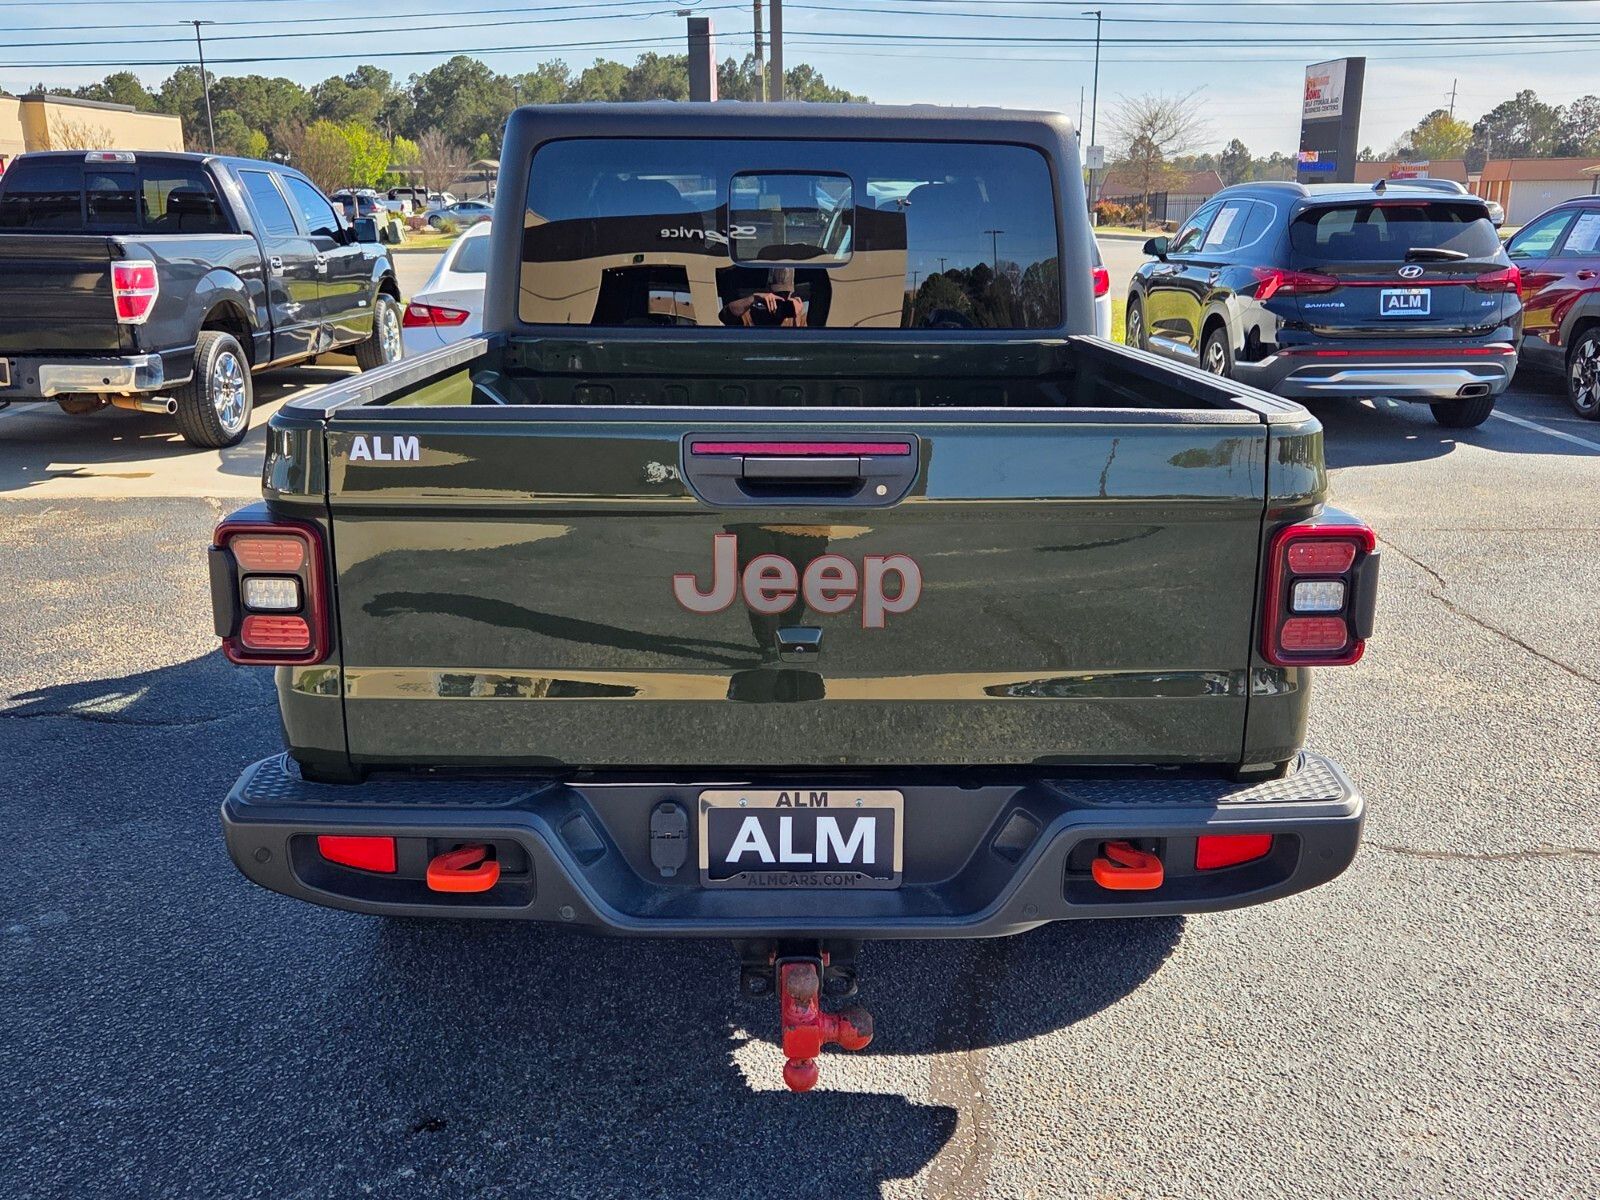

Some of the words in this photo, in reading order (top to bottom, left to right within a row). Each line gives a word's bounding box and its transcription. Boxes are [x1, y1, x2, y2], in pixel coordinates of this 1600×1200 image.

[1388, 295, 1422, 308] ALM
[349, 435, 421, 462] ALM
[673, 533, 922, 628] Jeep
[775, 791, 828, 807] ALM
[725, 816, 876, 864] ALM
[747, 874, 856, 886] ALMCARS.COM
